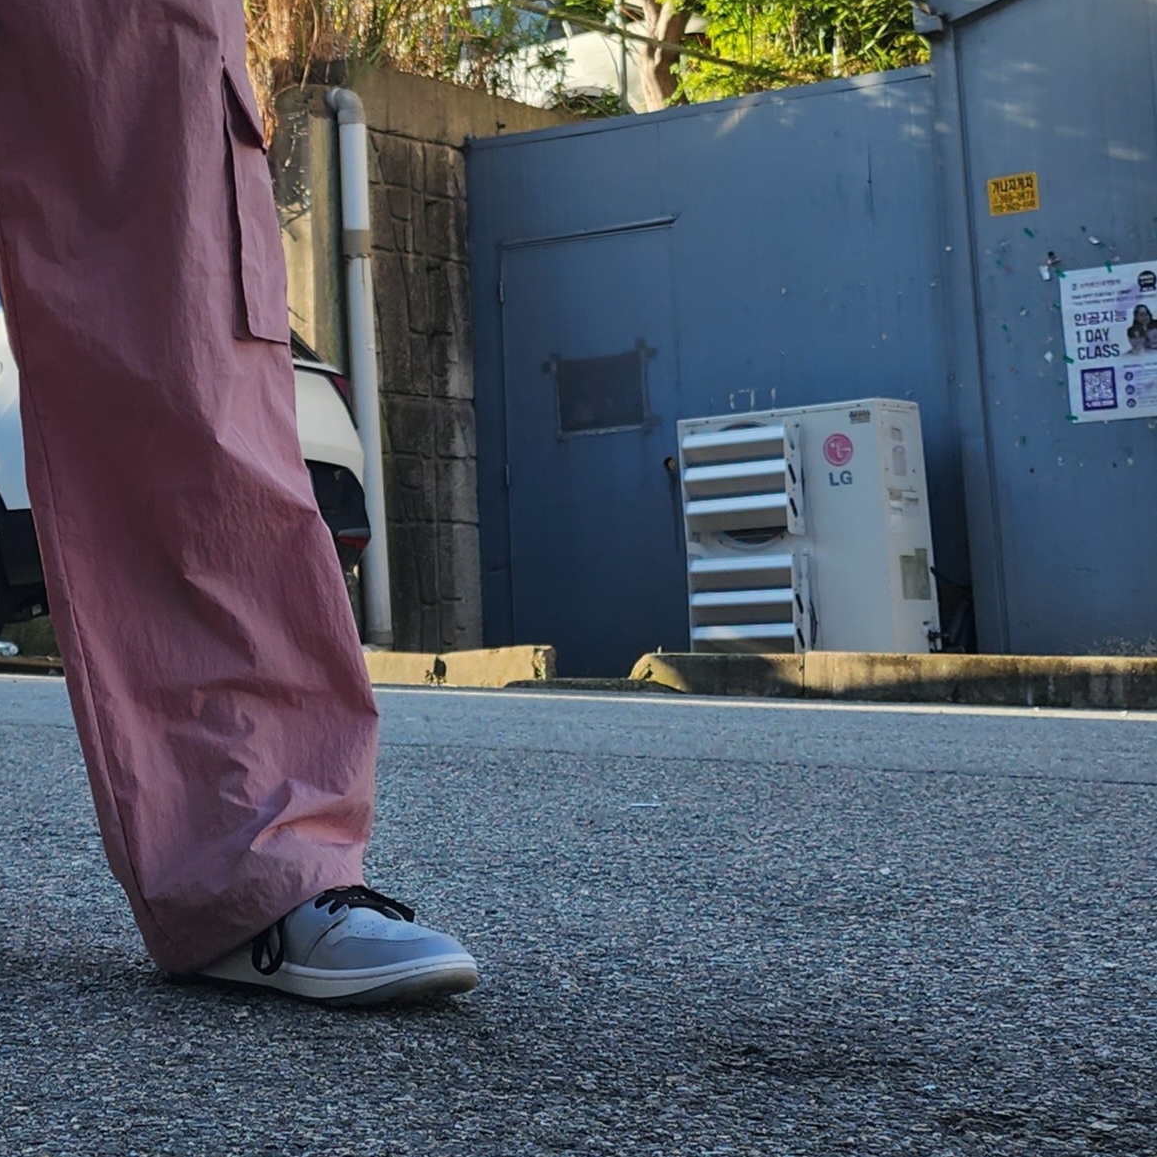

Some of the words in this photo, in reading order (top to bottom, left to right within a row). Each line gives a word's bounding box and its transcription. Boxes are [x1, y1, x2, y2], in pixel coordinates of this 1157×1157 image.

[1074, 310, 1127, 326] 인공지능
[1076, 330, 1081, 343] 1
[1085, 327, 1109, 343] DAY
[1077, 344, 1120, 360] CLASS
[829, 470, 853, 487] LG
